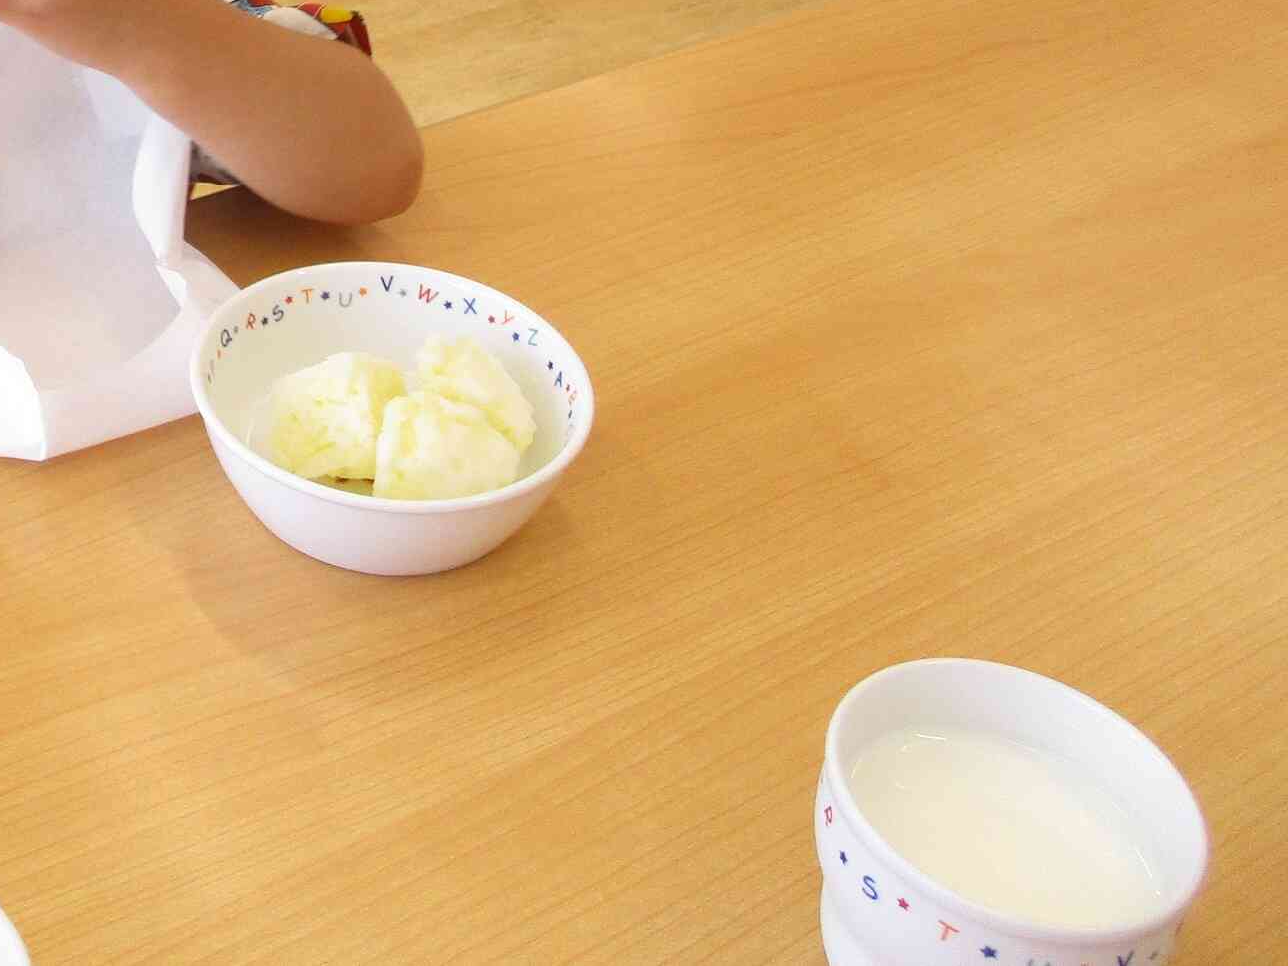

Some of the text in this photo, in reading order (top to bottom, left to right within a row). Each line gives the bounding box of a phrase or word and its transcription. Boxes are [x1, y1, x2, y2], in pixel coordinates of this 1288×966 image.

[220, 328, 233, 348] Q
[246, 312, 257, 330] R
[272, 304, 285, 322] S
[301, 288, 314, 304] T
[338, 291, 353, 308] U
[380, 275, 394, 293] V
[417, 283, 440, 304] W
[462, 297, 478, 315] X
[527, 327, 539, 347] Z
[862, 875, 879, 901] S
[938, 919, 961, 942] T
